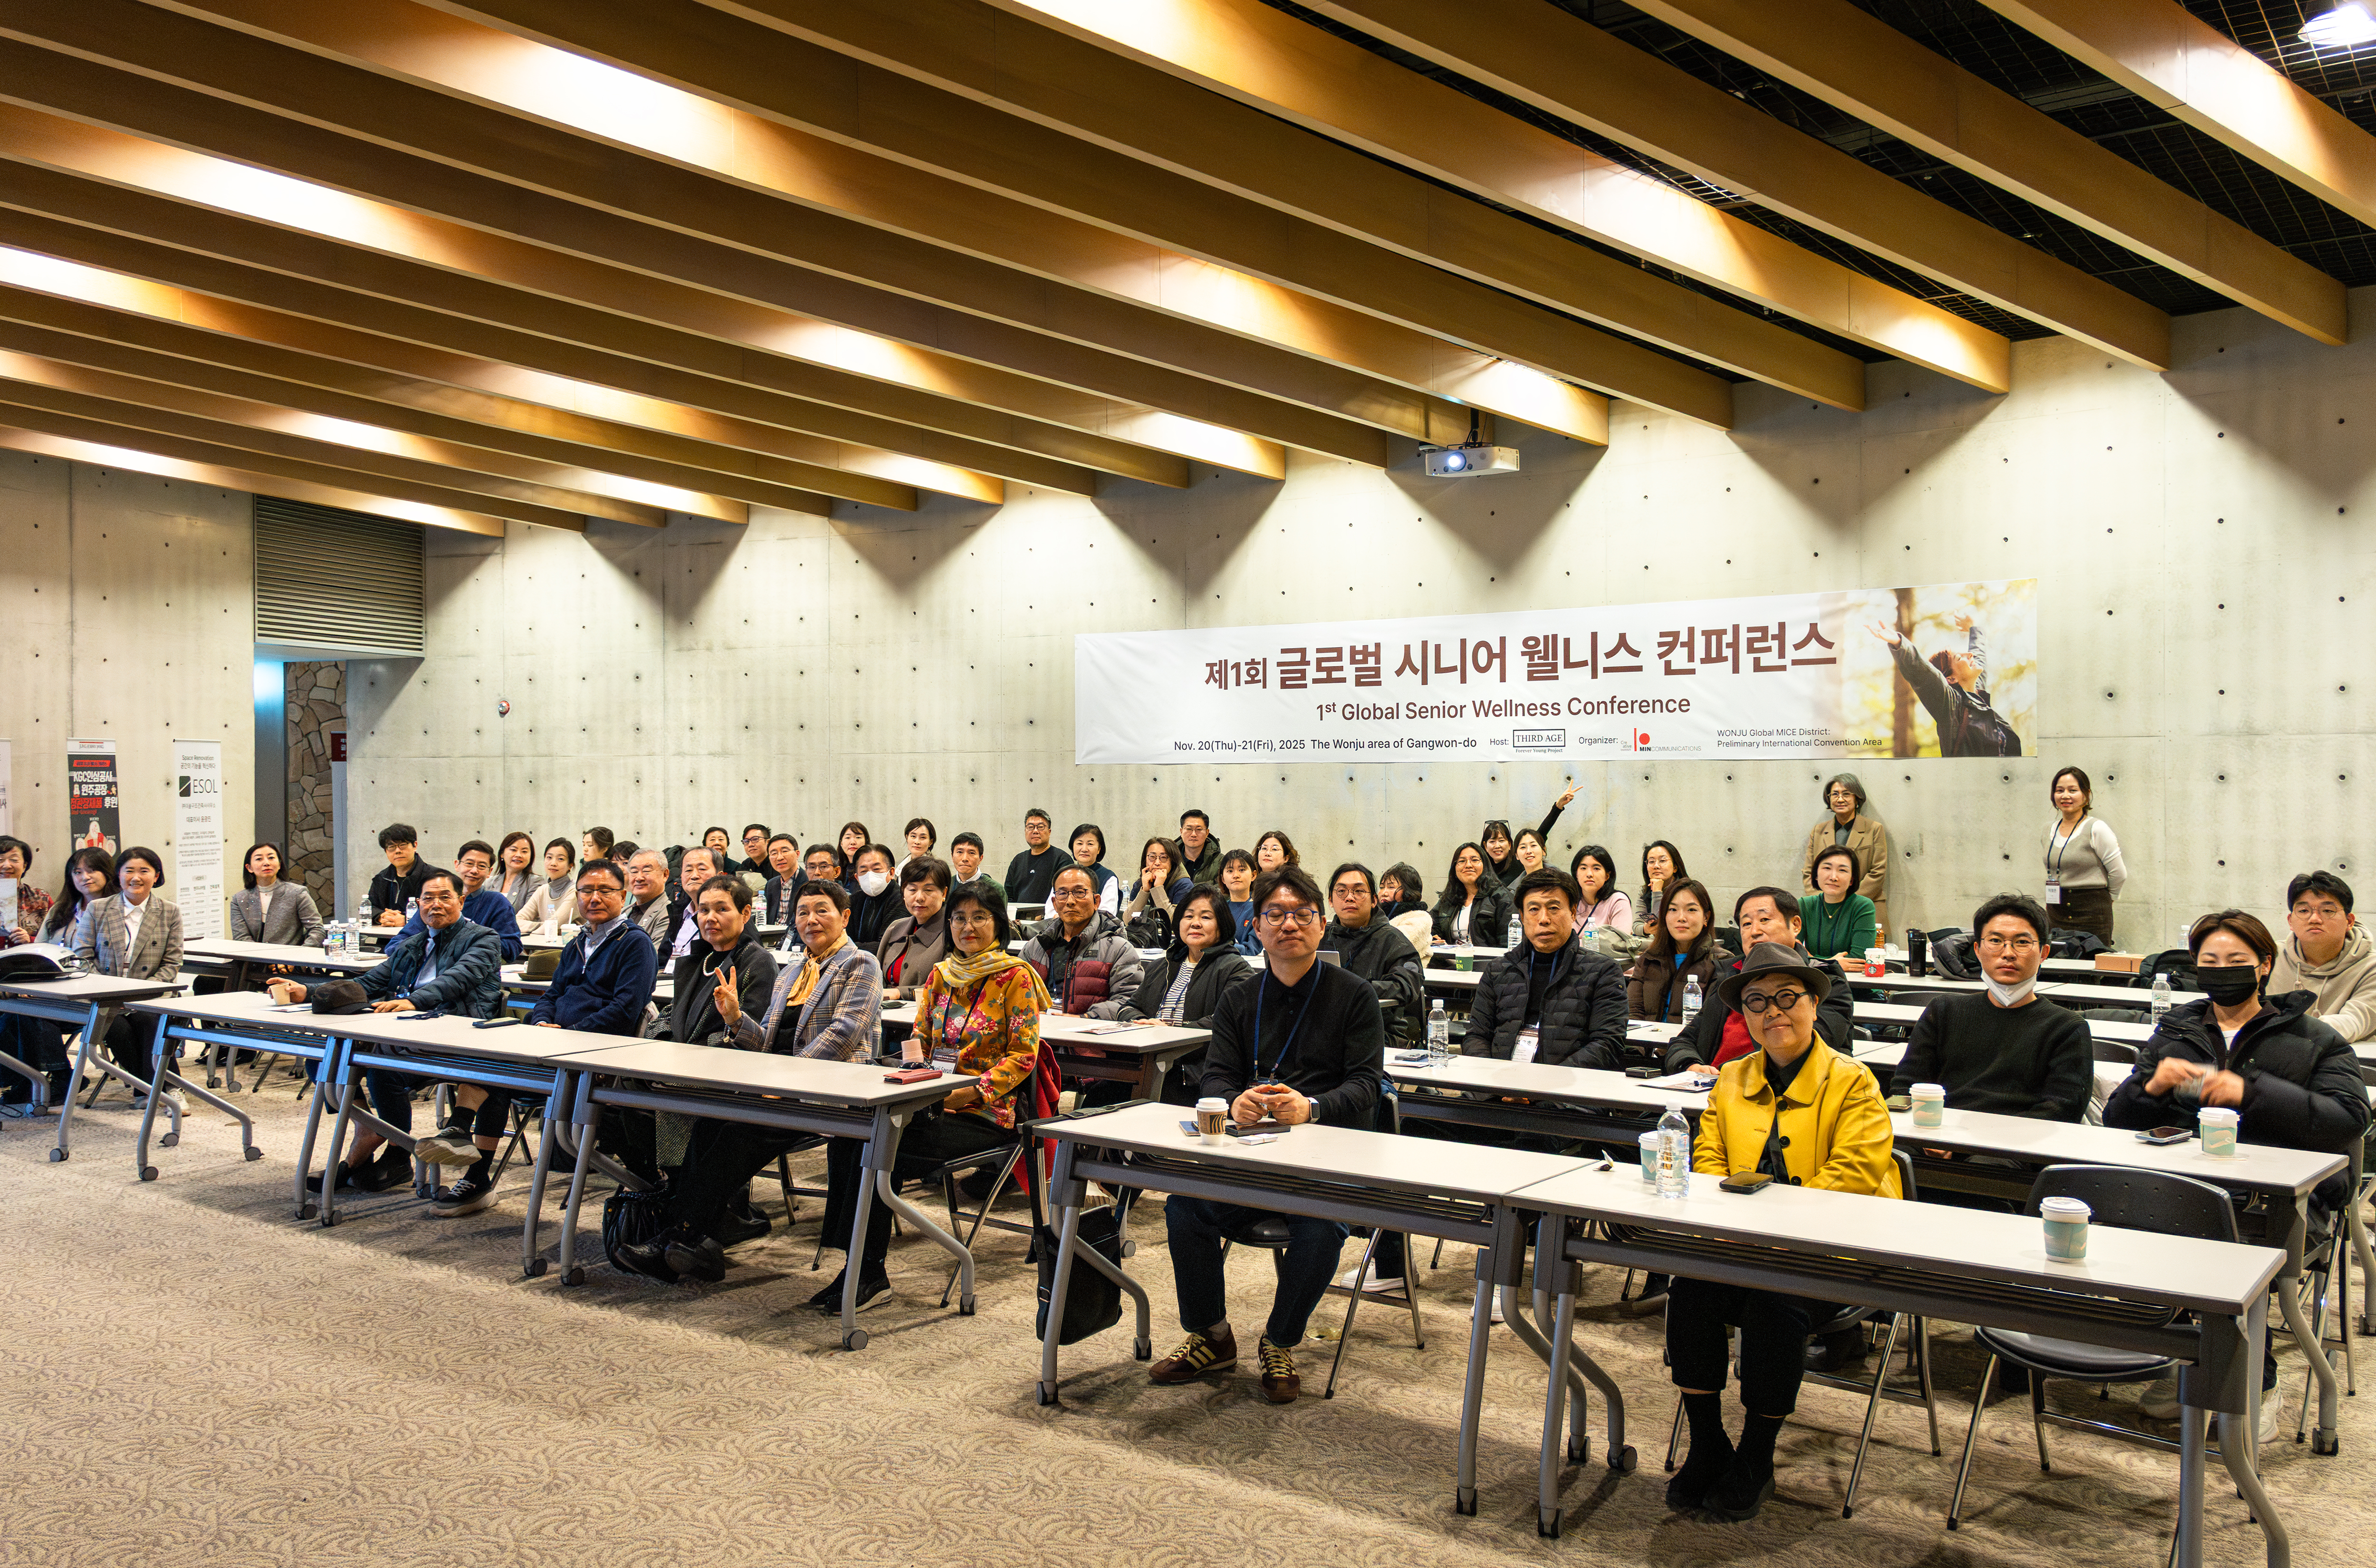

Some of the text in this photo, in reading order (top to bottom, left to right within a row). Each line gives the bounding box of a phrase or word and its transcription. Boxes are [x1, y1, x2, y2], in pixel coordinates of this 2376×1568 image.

[1205, 621, 1837, 690] 제1회 글로벌 시니어 웰니스 컨퍼런스
[1317, 696, 1690, 720] 1st Global Senior Wellness Conference
[1175, 742, 1195, 750] Nov.
[1198, 740, 1275, 752] 20(Thu)-21(Fri),
[1279, 740, 1305, 749] 2025
[1311, 740, 1330, 749] The
[1333, 739, 1364, 751] Wonju
[1393, 738, 1403, 748] of
[1407, 737, 1476, 750] Gangwon-do
[1579, 736, 1618, 746] Organizer:
[1718, 740, 1760, 748] Preliminary
[73, 771, 112, 783] KGC인삼공사
[81, 784, 107, 796] 원주공장
[193, 779, 218, 794] ESOL
[104, 796, 118, 808] 후원
